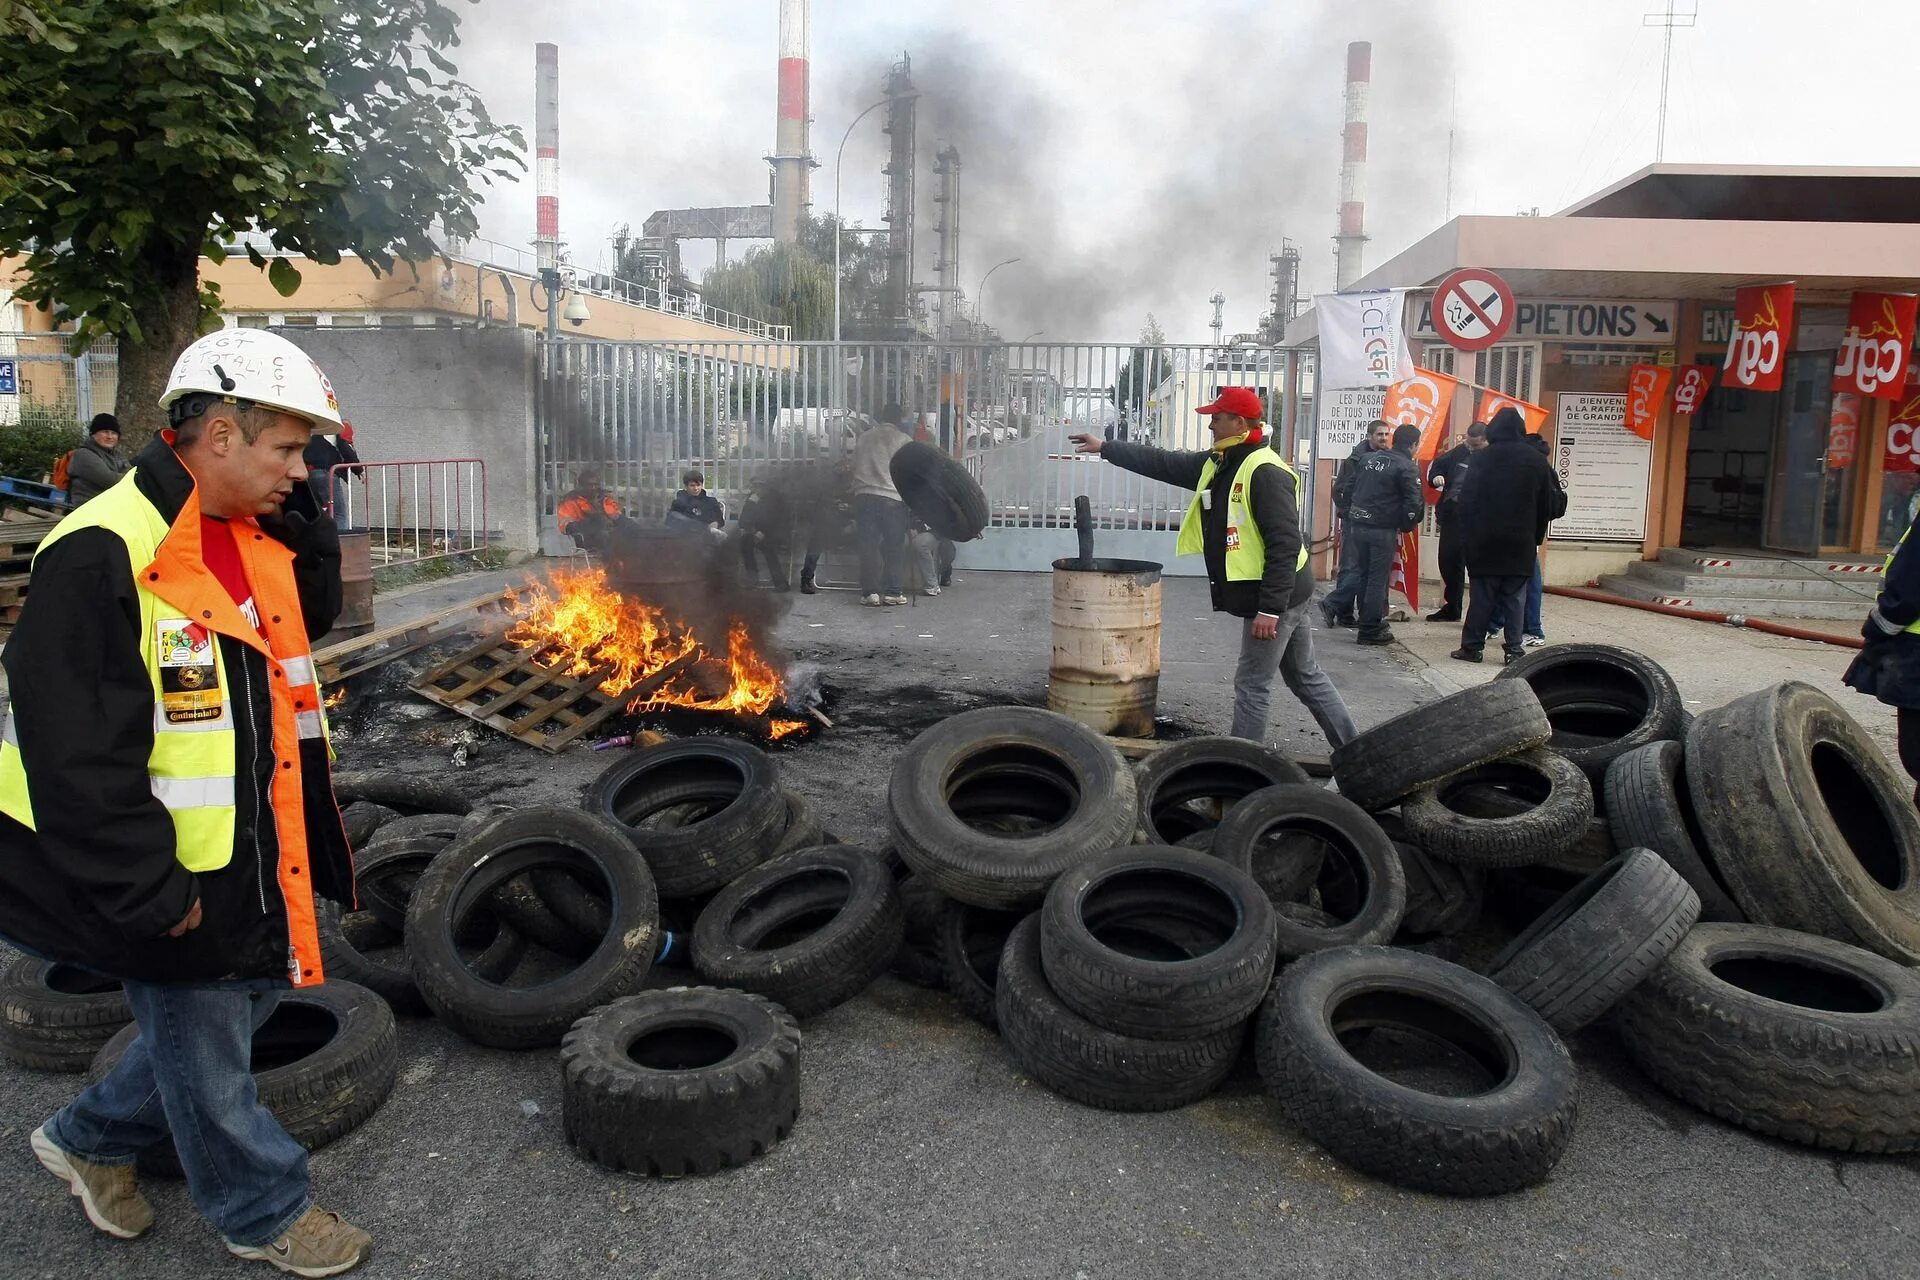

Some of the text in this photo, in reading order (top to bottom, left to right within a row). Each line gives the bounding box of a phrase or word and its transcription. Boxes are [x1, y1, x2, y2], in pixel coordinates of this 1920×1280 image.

[1516, 303, 1636, 337] PIETONS
[1702, 310, 1735, 342] EN
[198, 337, 254, 349] CGT
[1339, 393, 1386, 405] LES PASSAG
[1580, 397, 1627, 405] BIENVENU
[1331, 406, 1341, 417] DE
[1345, 407, 1363, 418] TOUS
[1583, 413, 1624, 421] GRANDP
[1321, 419, 1350, 430] DOIVENT
[1328, 433, 1355, 443] PASSER
[1226, 532, 1239, 546] gt
[161, 632, 169, 662] FNIC
[194, 640, 210, 652] CGT
